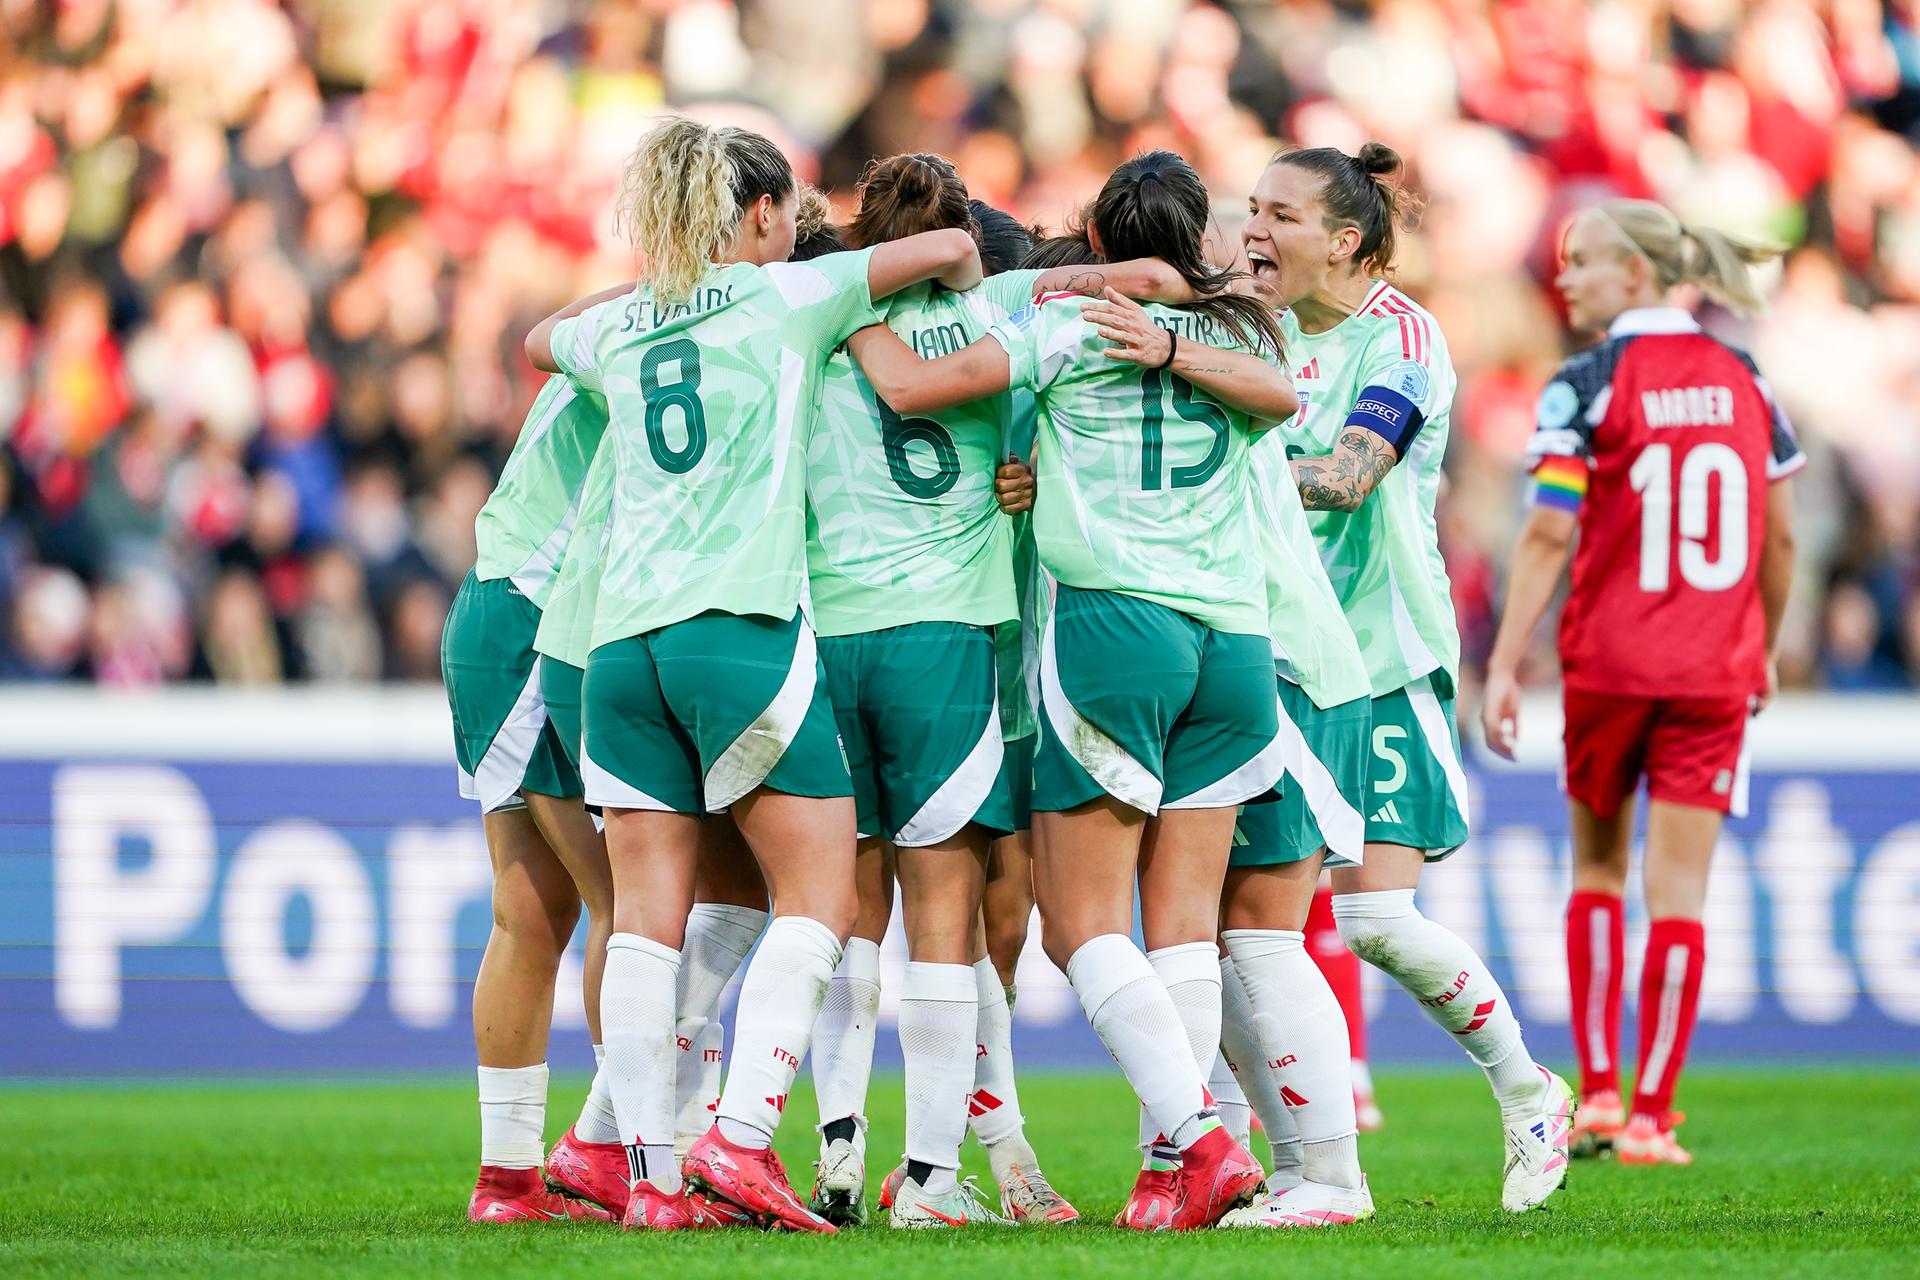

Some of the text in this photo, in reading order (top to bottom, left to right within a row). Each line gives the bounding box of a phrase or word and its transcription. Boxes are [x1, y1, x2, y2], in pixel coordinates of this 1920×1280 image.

[640, 337, 708, 475] 8
[1140, 367, 1231, 491] 15
[1353, 401, 1401, 423] RESPECT
[1640, 385, 1735, 430] HARDER
[875, 390, 962, 500] 6
[1371, 724, 1409, 794] 5
[1267, 1053, 1298, 1070] LIA
